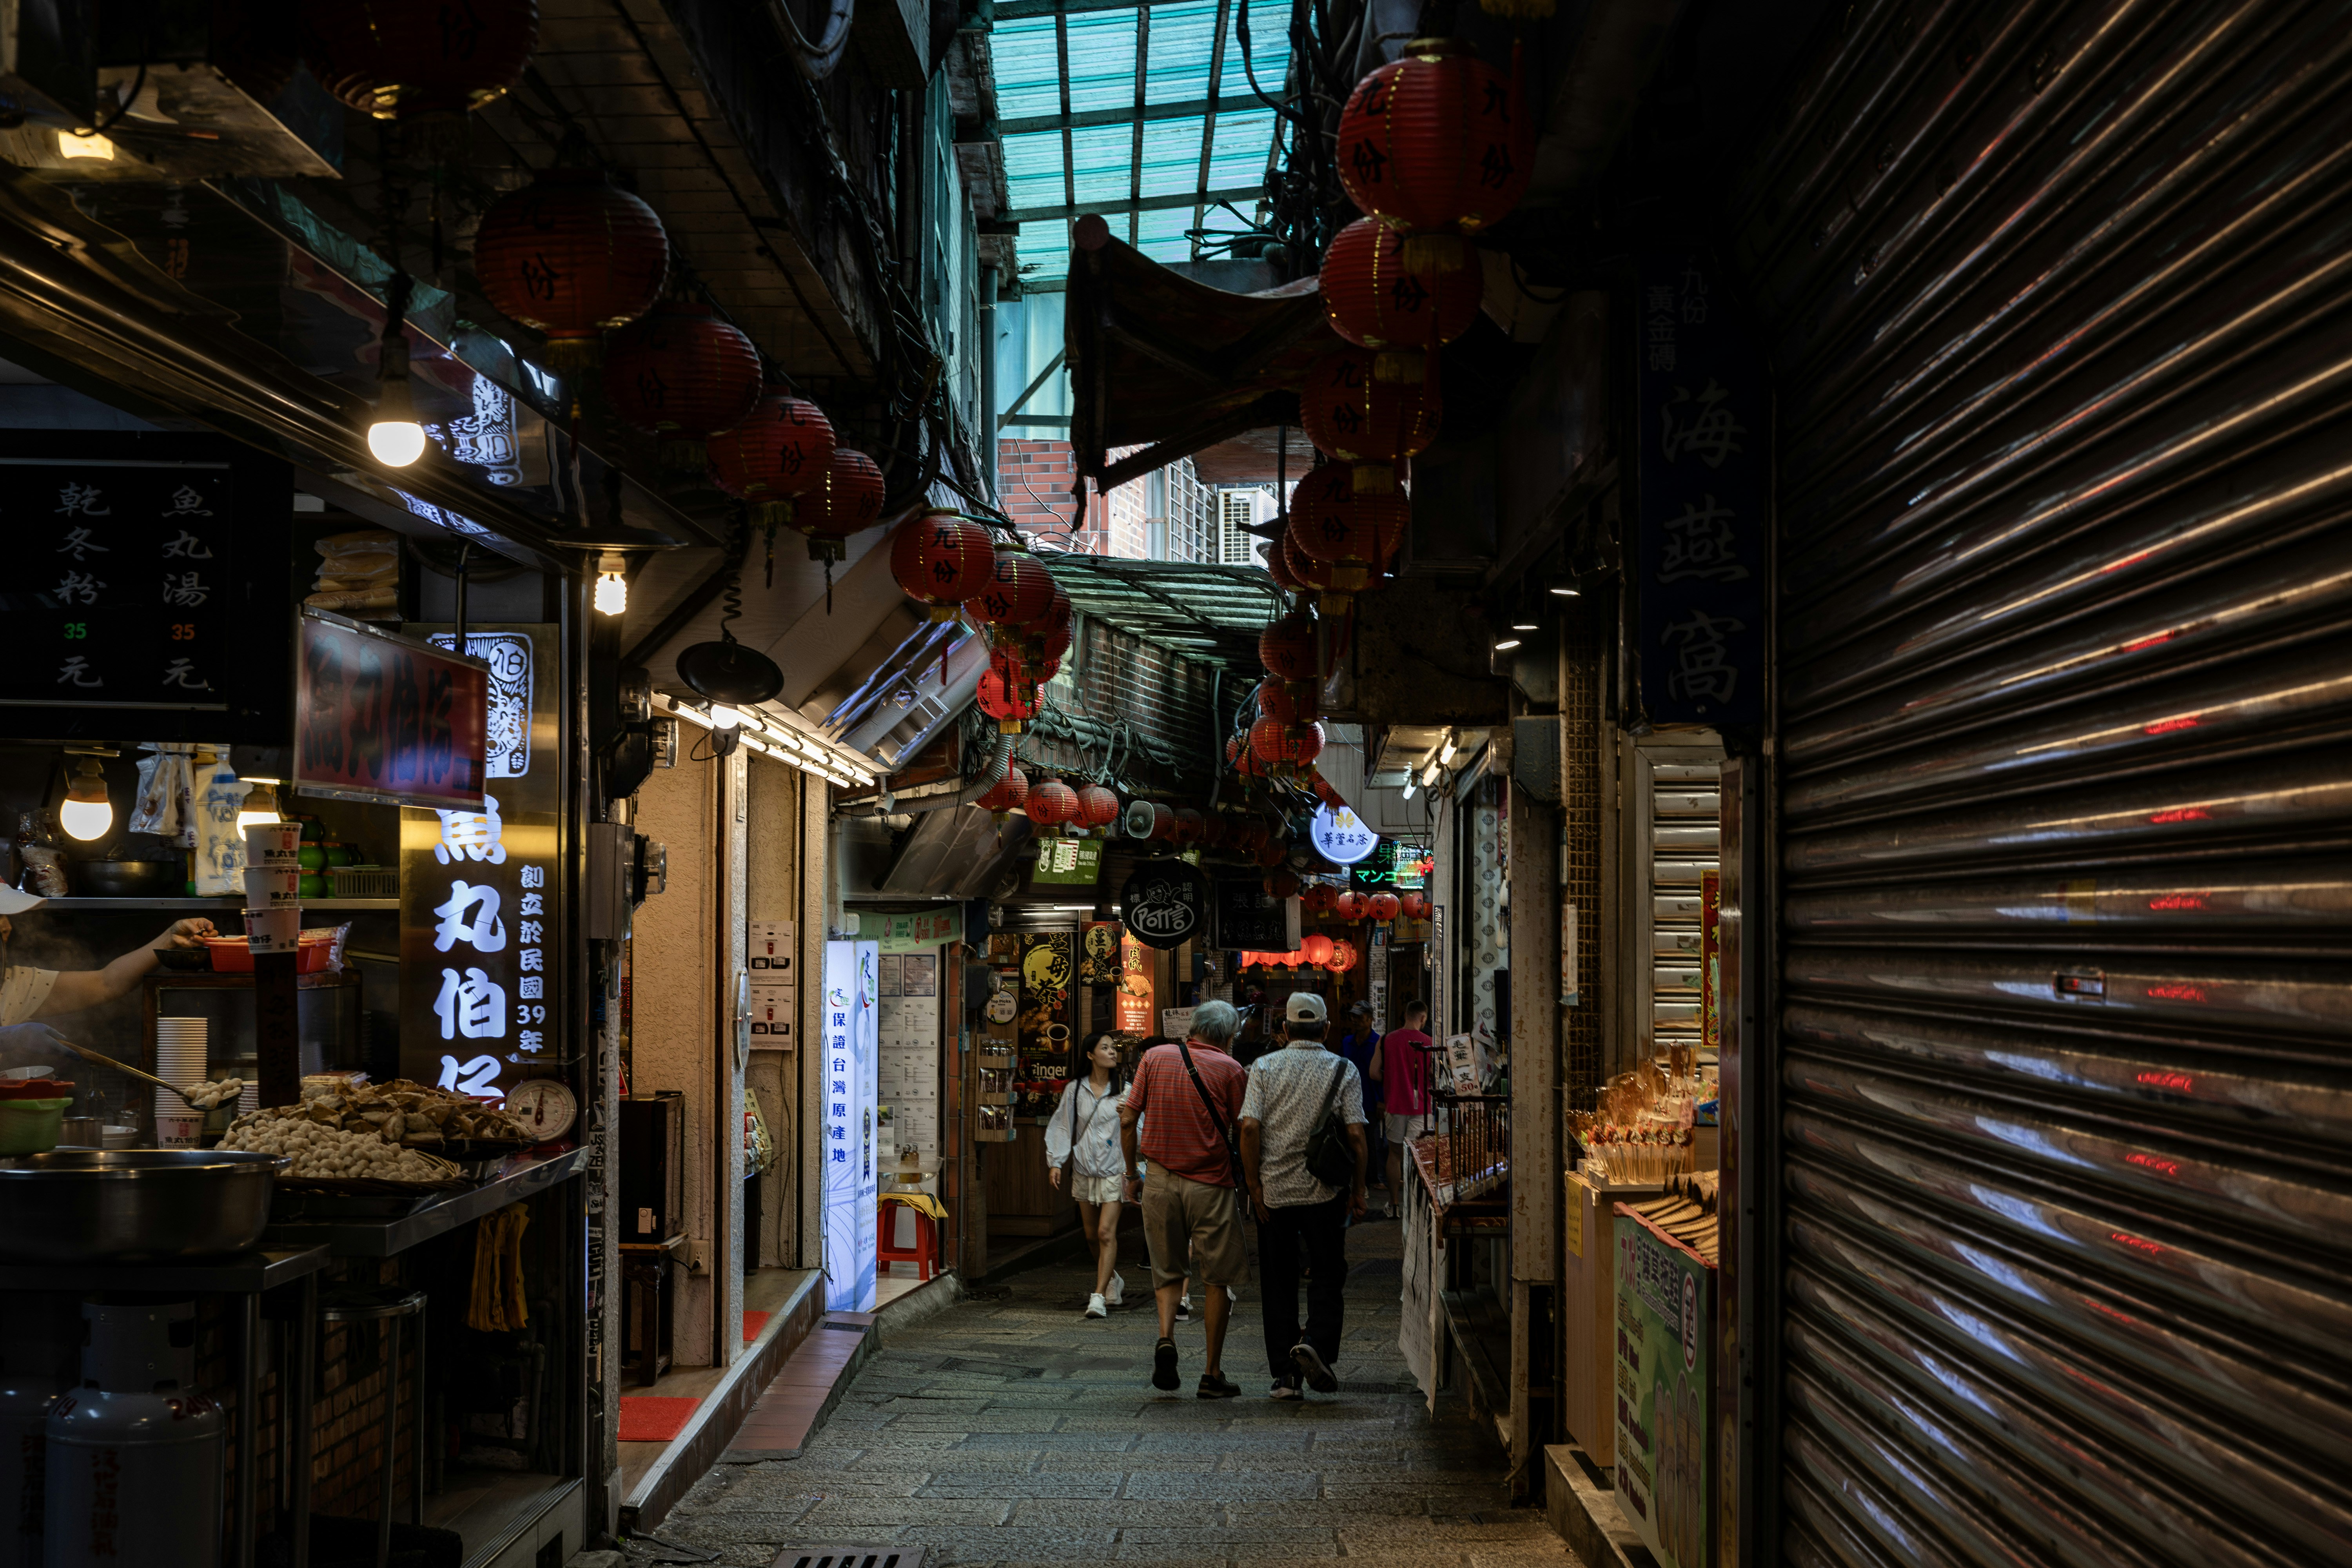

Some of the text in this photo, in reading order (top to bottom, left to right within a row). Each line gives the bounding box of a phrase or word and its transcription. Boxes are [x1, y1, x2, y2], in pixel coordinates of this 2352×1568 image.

[1353, 78, 1386, 184] 九份
[1482, 80, 1514, 189] 九份
[519, 197, 559, 301] 九份
[1680, 267, 1709, 325] 九份
[637, 323, 669, 409] 九份
[1331, 360, 1363, 434] 九份
[778, 403, 806, 476] 九份
[1322, 477, 1351, 542] 九份
[1655, 376, 1751, 705] 海燕窩
[932, 528, 957, 584] 九份
[1129, 884, 1141, 903] 商標
[1182, 882, 1193, 902] 認明
[517, 865, 546, 1053] 創立於民國39年
[831, 1012, 846, 1162] 保證台灣原產地
[1452, 1040, 1473, 1083] 毛筆一支
[1621, 1224, 1636, 1291] 九份
